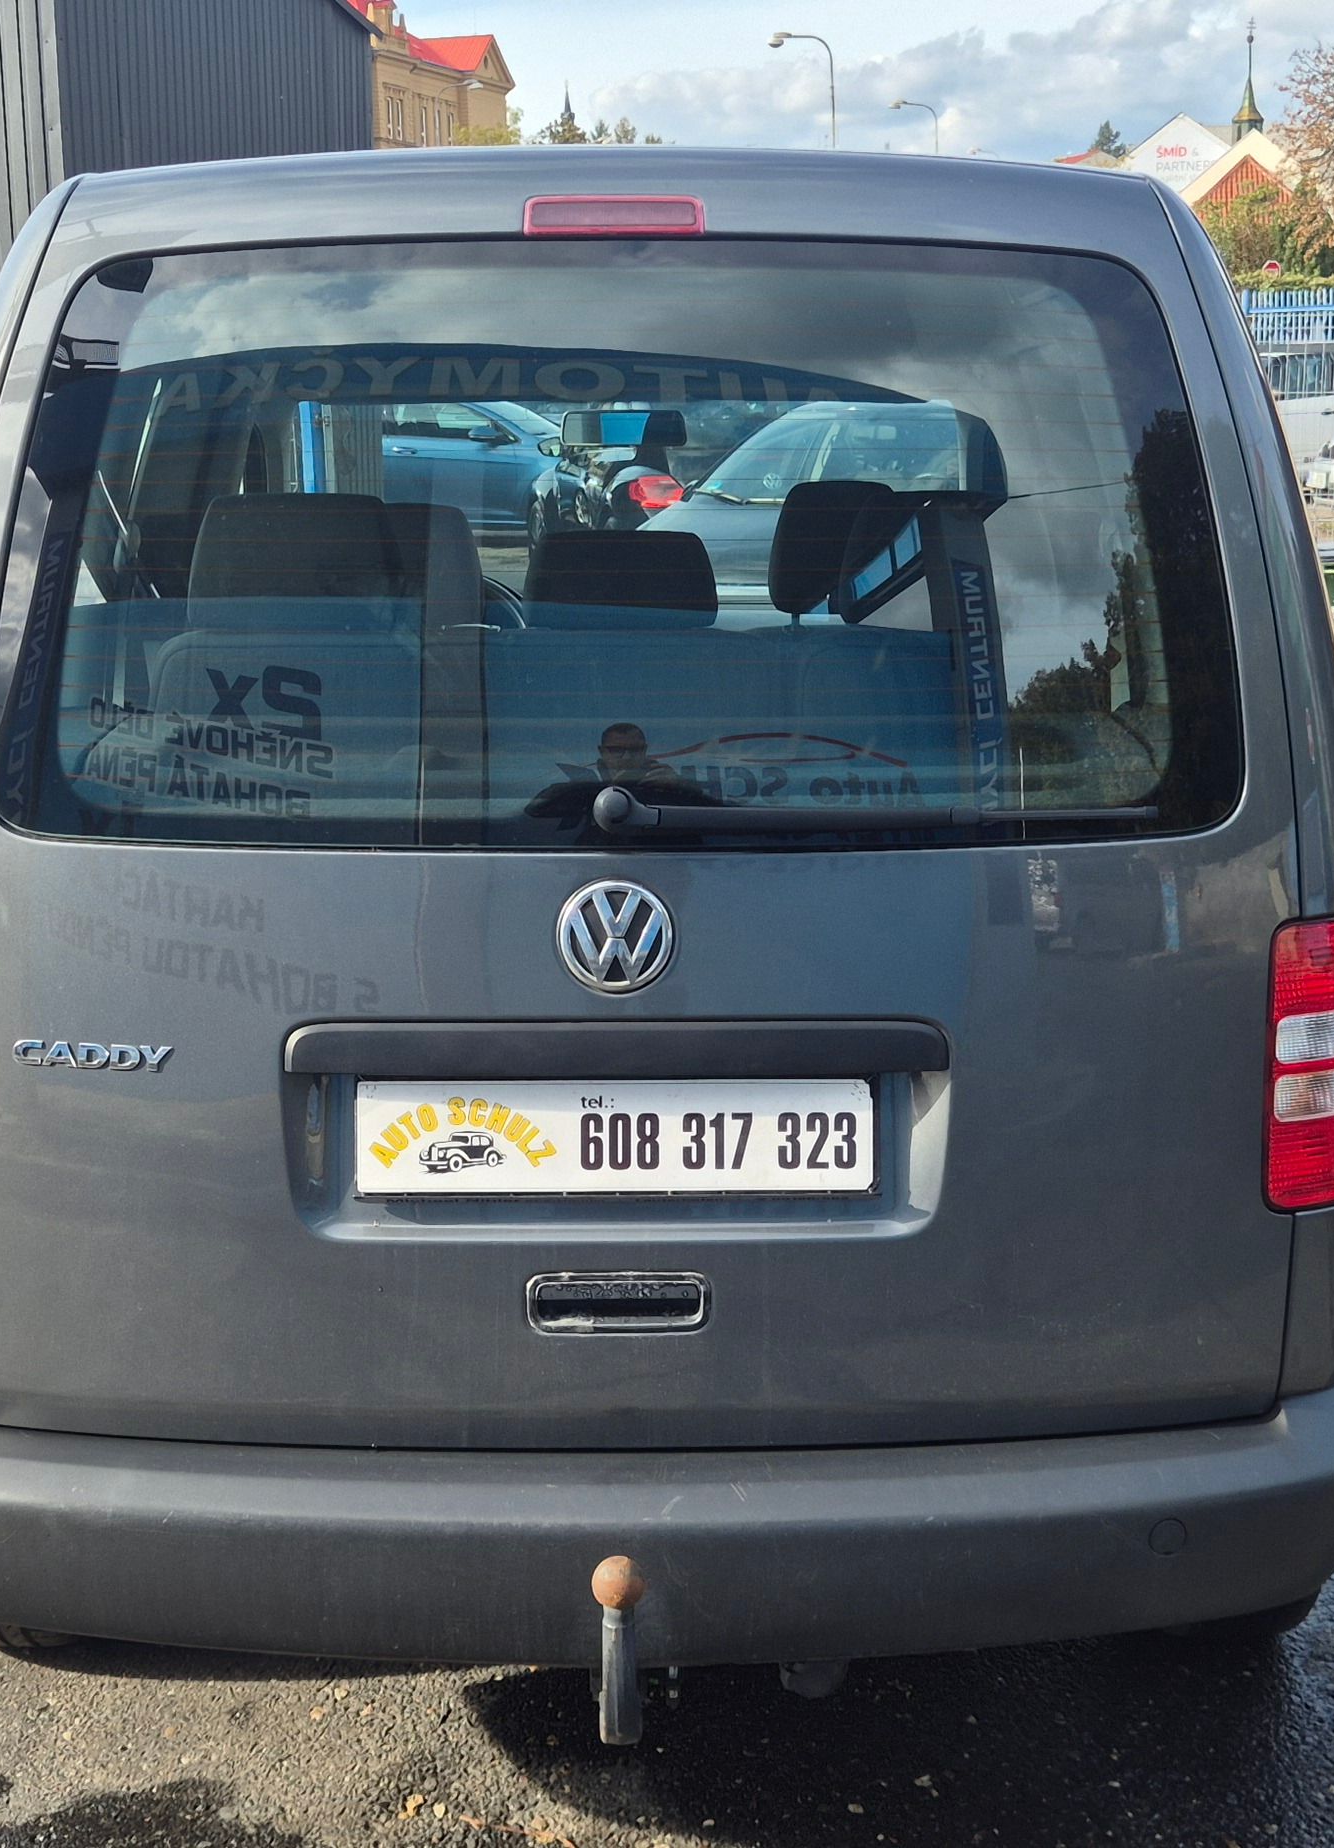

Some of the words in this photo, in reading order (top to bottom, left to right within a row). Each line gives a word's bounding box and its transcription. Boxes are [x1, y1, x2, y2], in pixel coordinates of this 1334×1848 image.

[1156, 144, 1187, 158] ŠMÍD
[12, 1039, 173, 1073] CADDY
[581, 1096, 615, 1109] tel.:
[369, 1103, 439, 1169] AUTO
[447, 1097, 557, 1167] SCHULZ
[580, 1113, 660, 1171] 608
[682, 1112, 754, 1170] 317
[777, 1112, 857, 1170] 323
